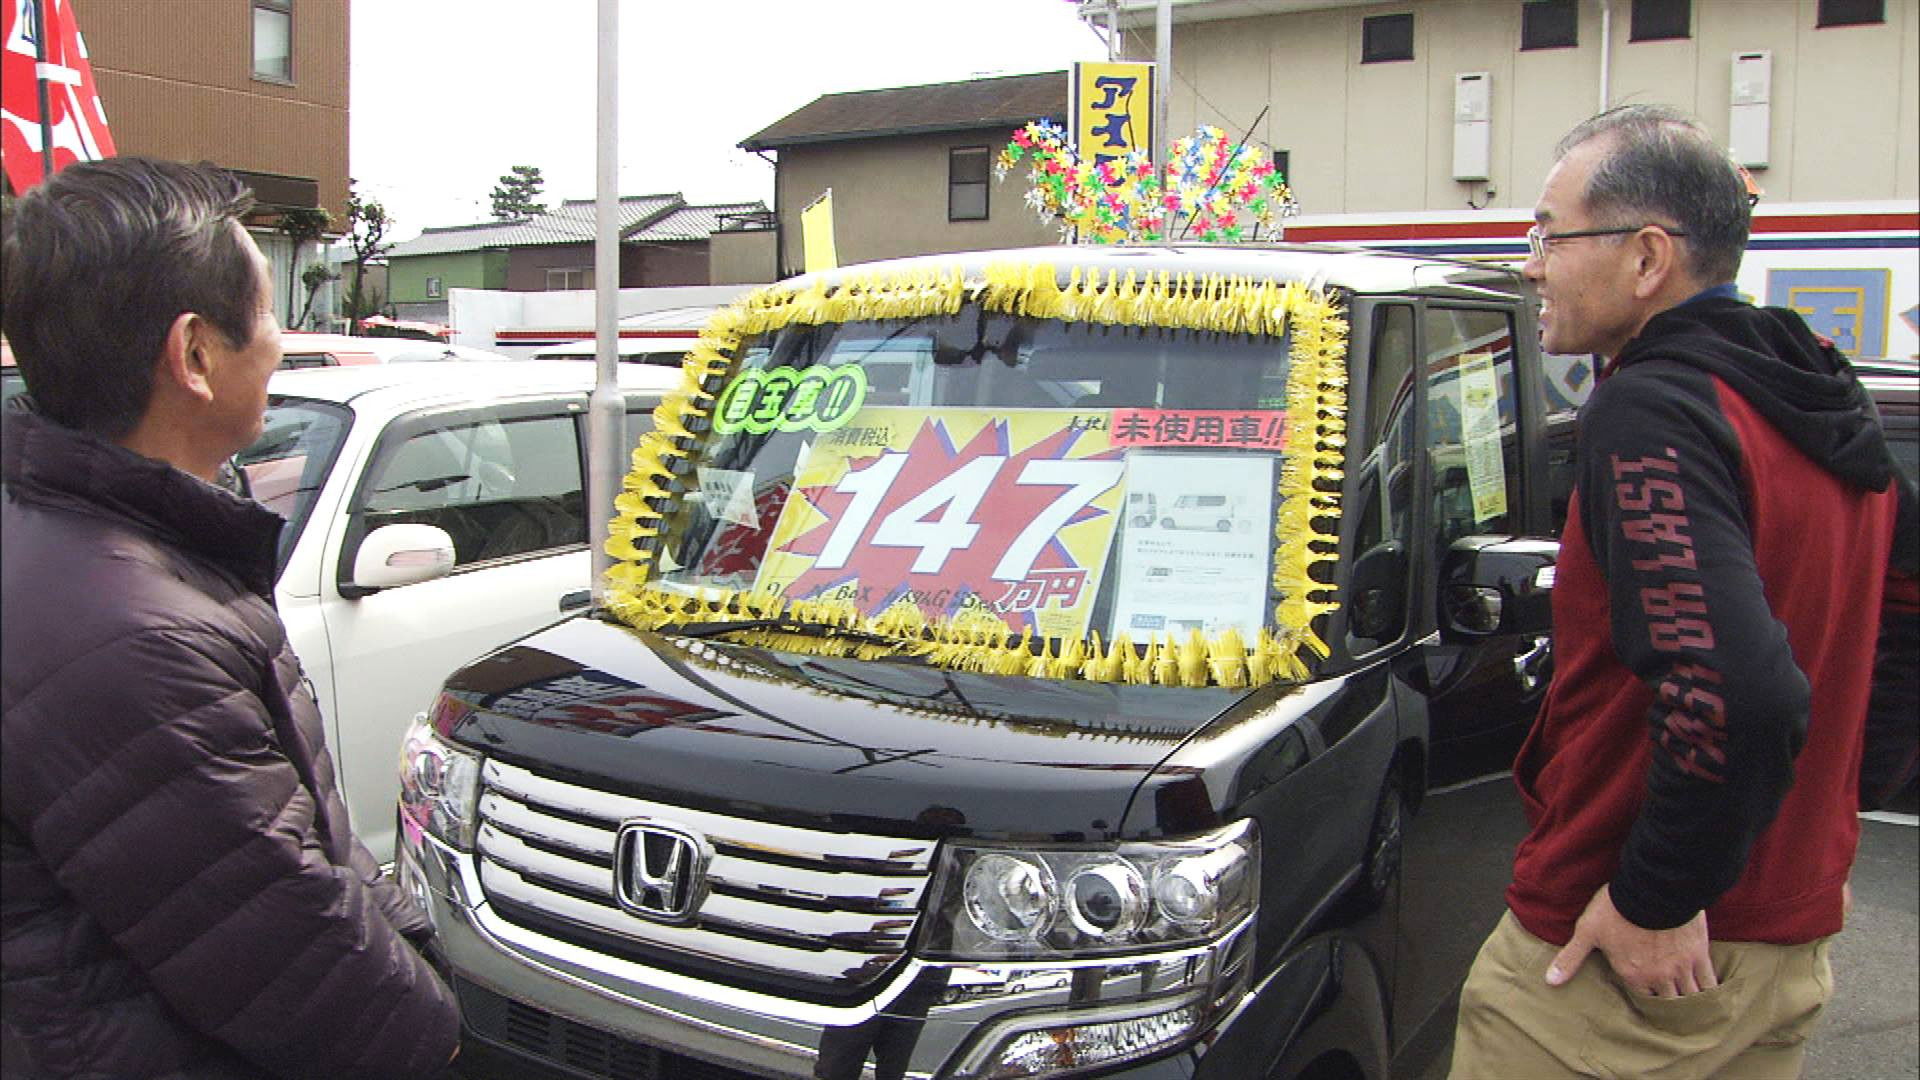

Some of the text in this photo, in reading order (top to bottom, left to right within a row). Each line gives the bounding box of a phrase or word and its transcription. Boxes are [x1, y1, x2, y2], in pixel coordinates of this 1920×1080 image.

[1115, 412, 1286, 446] 未使用車!!
[813, 450, 1126, 581] 147
